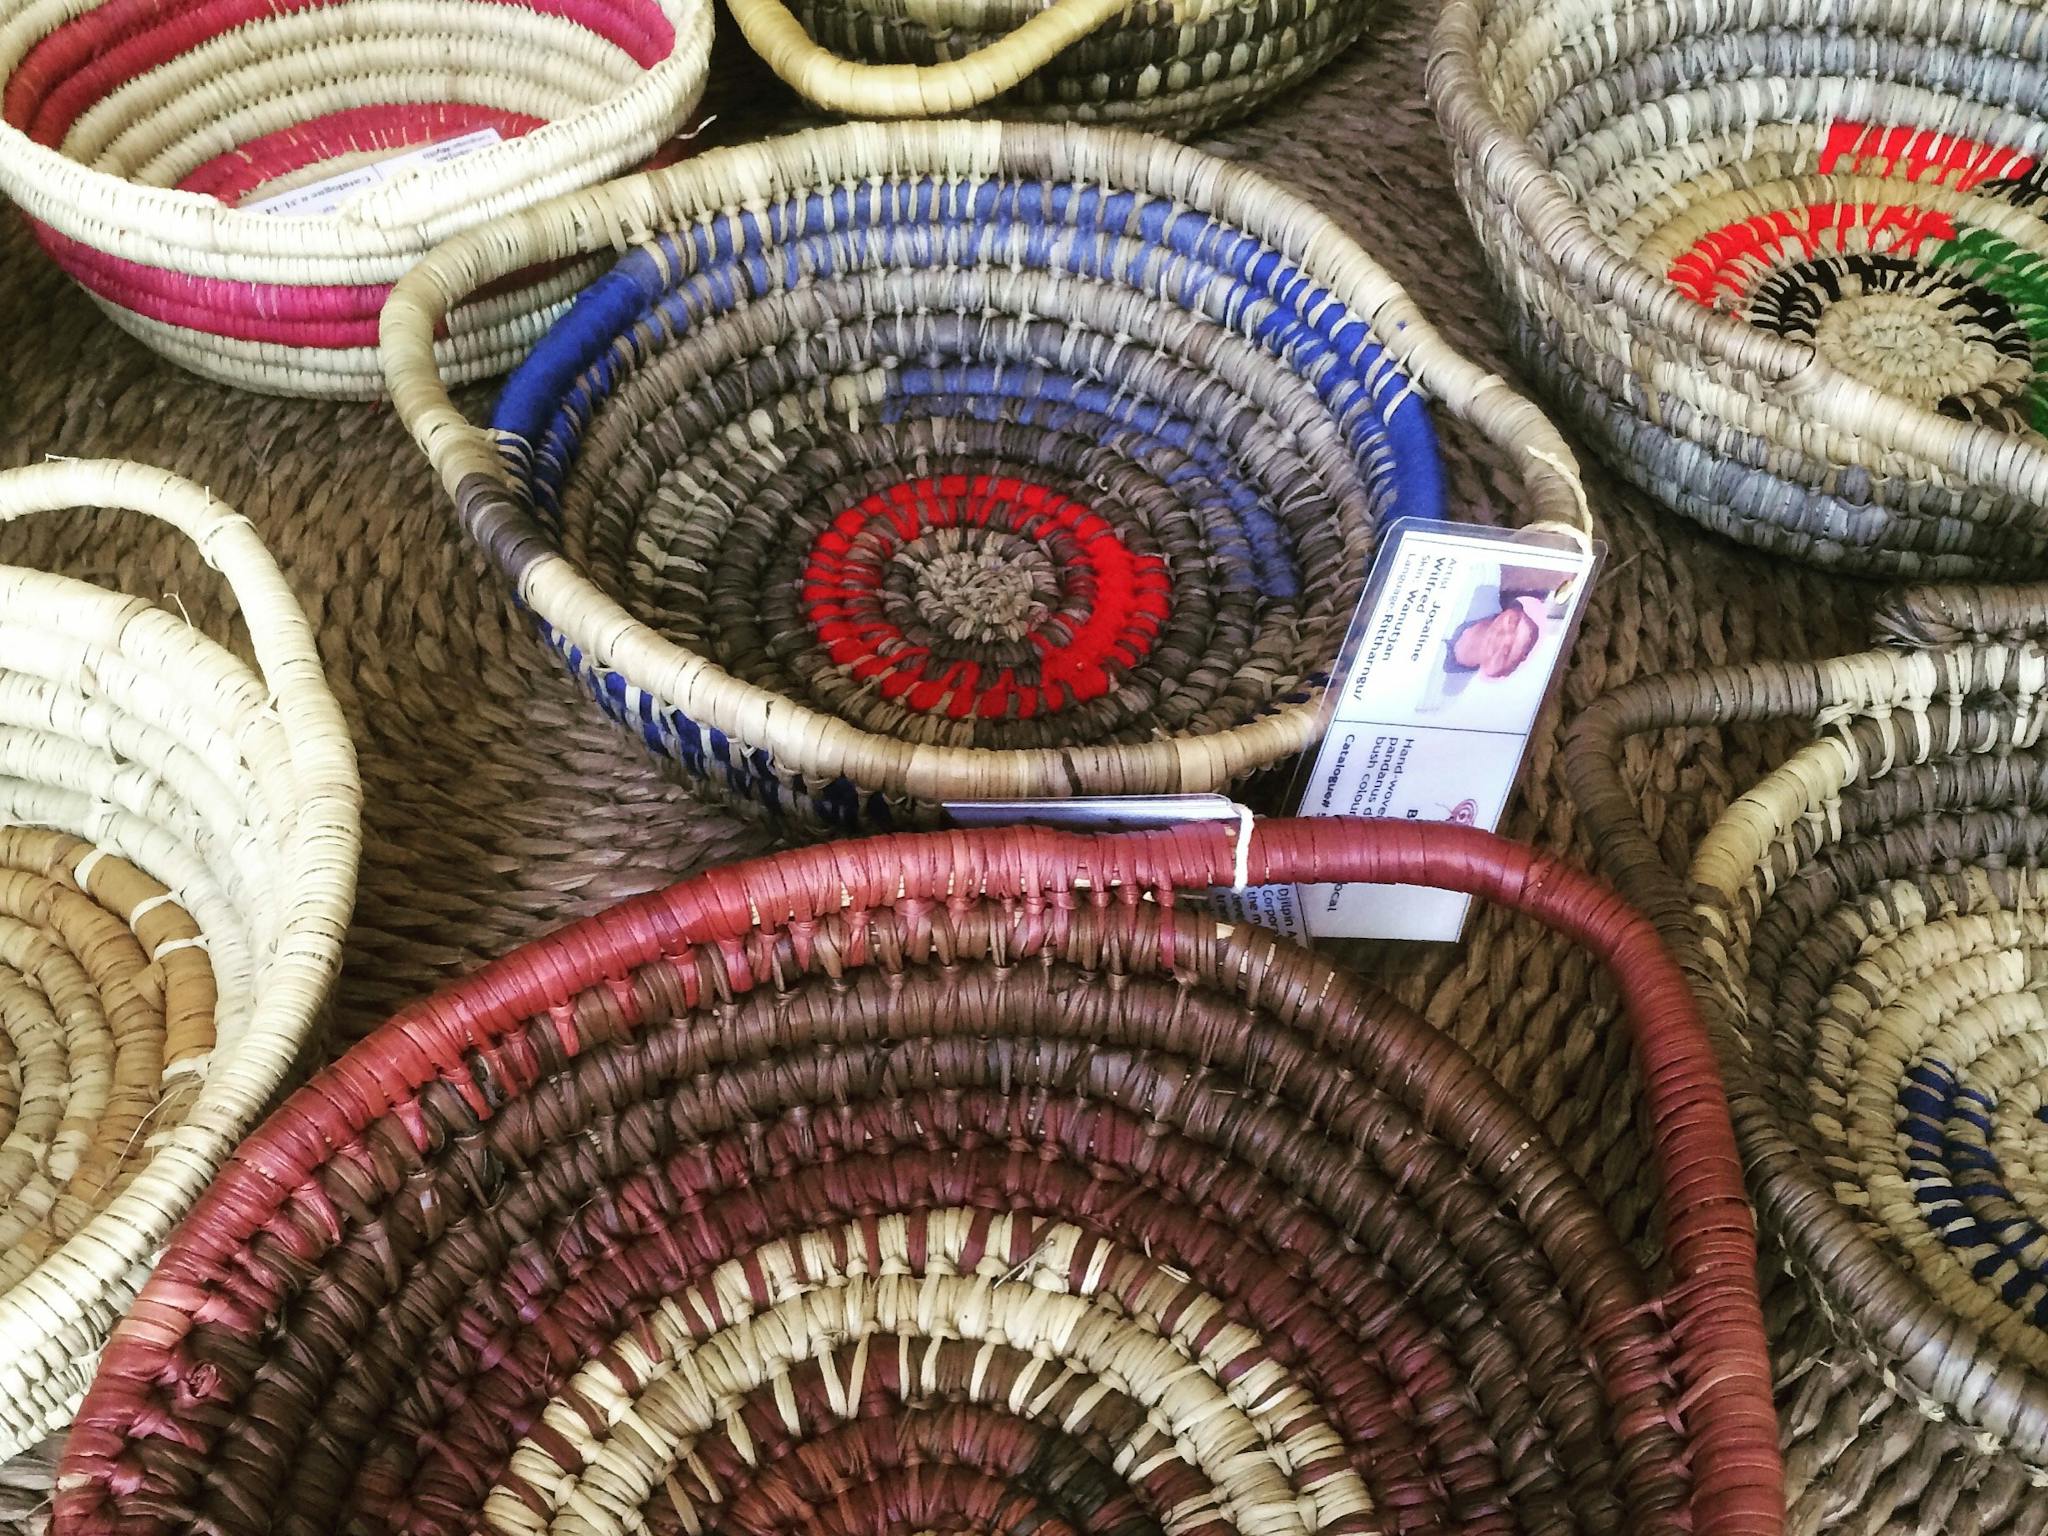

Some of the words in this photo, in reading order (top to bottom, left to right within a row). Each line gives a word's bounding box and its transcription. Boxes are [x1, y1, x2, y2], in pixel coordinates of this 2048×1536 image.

[311, 176, 371, 199] Catalogue
[1416, 557, 1446, 613] Wilfred
[1382, 589, 1419, 661] Wanutjan
[1411, 600, 1441, 662] Josaline
[1367, 736, 1387, 769] bush
[1368, 736, 1399, 803] pandanus
[1377, 738, 1415, 816] Hand-wove
[1247, 891, 1258, 911] the
[1277, 888, 1294, 926] Djilpin
[1327, 883, 1343, 912] ocal
